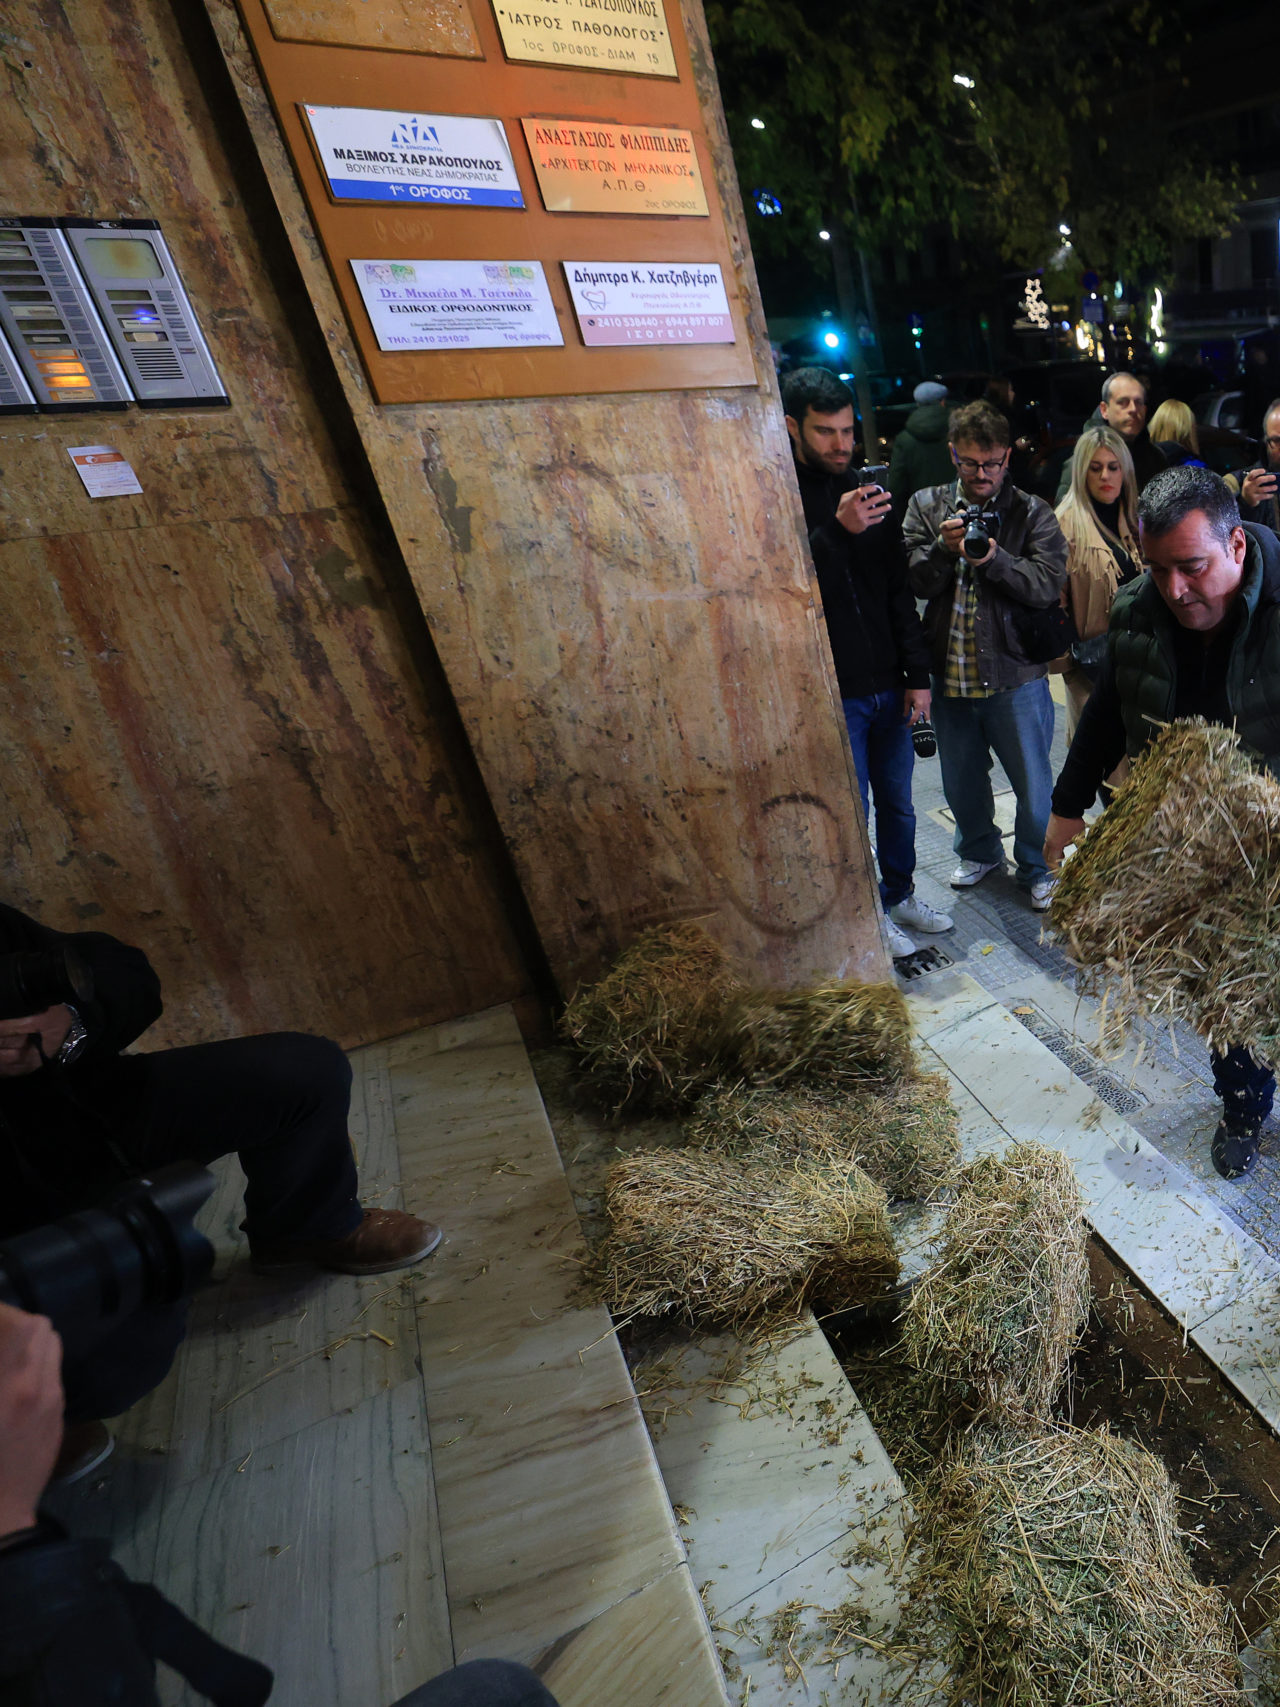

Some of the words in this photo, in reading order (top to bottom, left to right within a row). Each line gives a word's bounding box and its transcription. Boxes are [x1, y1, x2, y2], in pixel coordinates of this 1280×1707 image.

[508, 12, 564, 30] ΙΑΤΡΟΣ
[572, 20, 659, 42] ΠΑΘΟΛΟΓΟΣ
[535, 128, 615, 149] ΑΝΑΣΤΑΣΙΟΣ
[620, 136, 691, 154] ΦΙΛΙΠΠΙΔΗΣ
[333, 148, 398, 164] ΜΑΞΙΜΟΣ
[401, 152, 504, 172] ΧΑΡΑΚΟΠΟΥΛΟΣ
[547, 158, 616, 173] ΑΡΧΙΤΕΚΤΩΝ
[624, 163, 690, 177] ΜΗΧΑΝΙΚΟΣ
[345, 163, 406, 176] ΒΟΥΛΕΥΤΗΣ
[407, 167, 434, 179] ΝΕΑΣ
[435, 169, 500, 183] ΔΗΜΟΚΡΑΤΙΑΣ
[408, 185, 473, 201] ΟΡΟΦΟΣ
[574, 267, 629, 287] Δήμητρα
[631, 270, 646, 284] Κ.
[649, 269, 717, 287] Χατζηβγέρη
[380, 288, 402, 299] Dr.
[460, 288, 477, 299] Μ.
[389, 304, 439, 314] ΕΙΔΙΚΟΣ
[441, 304, 534, 314] ΟΡΘΟΔΟΝΤΙΚΟΣ
[598, 317, 623, 328] 2410
[412, 336, 435, 344] 2410
